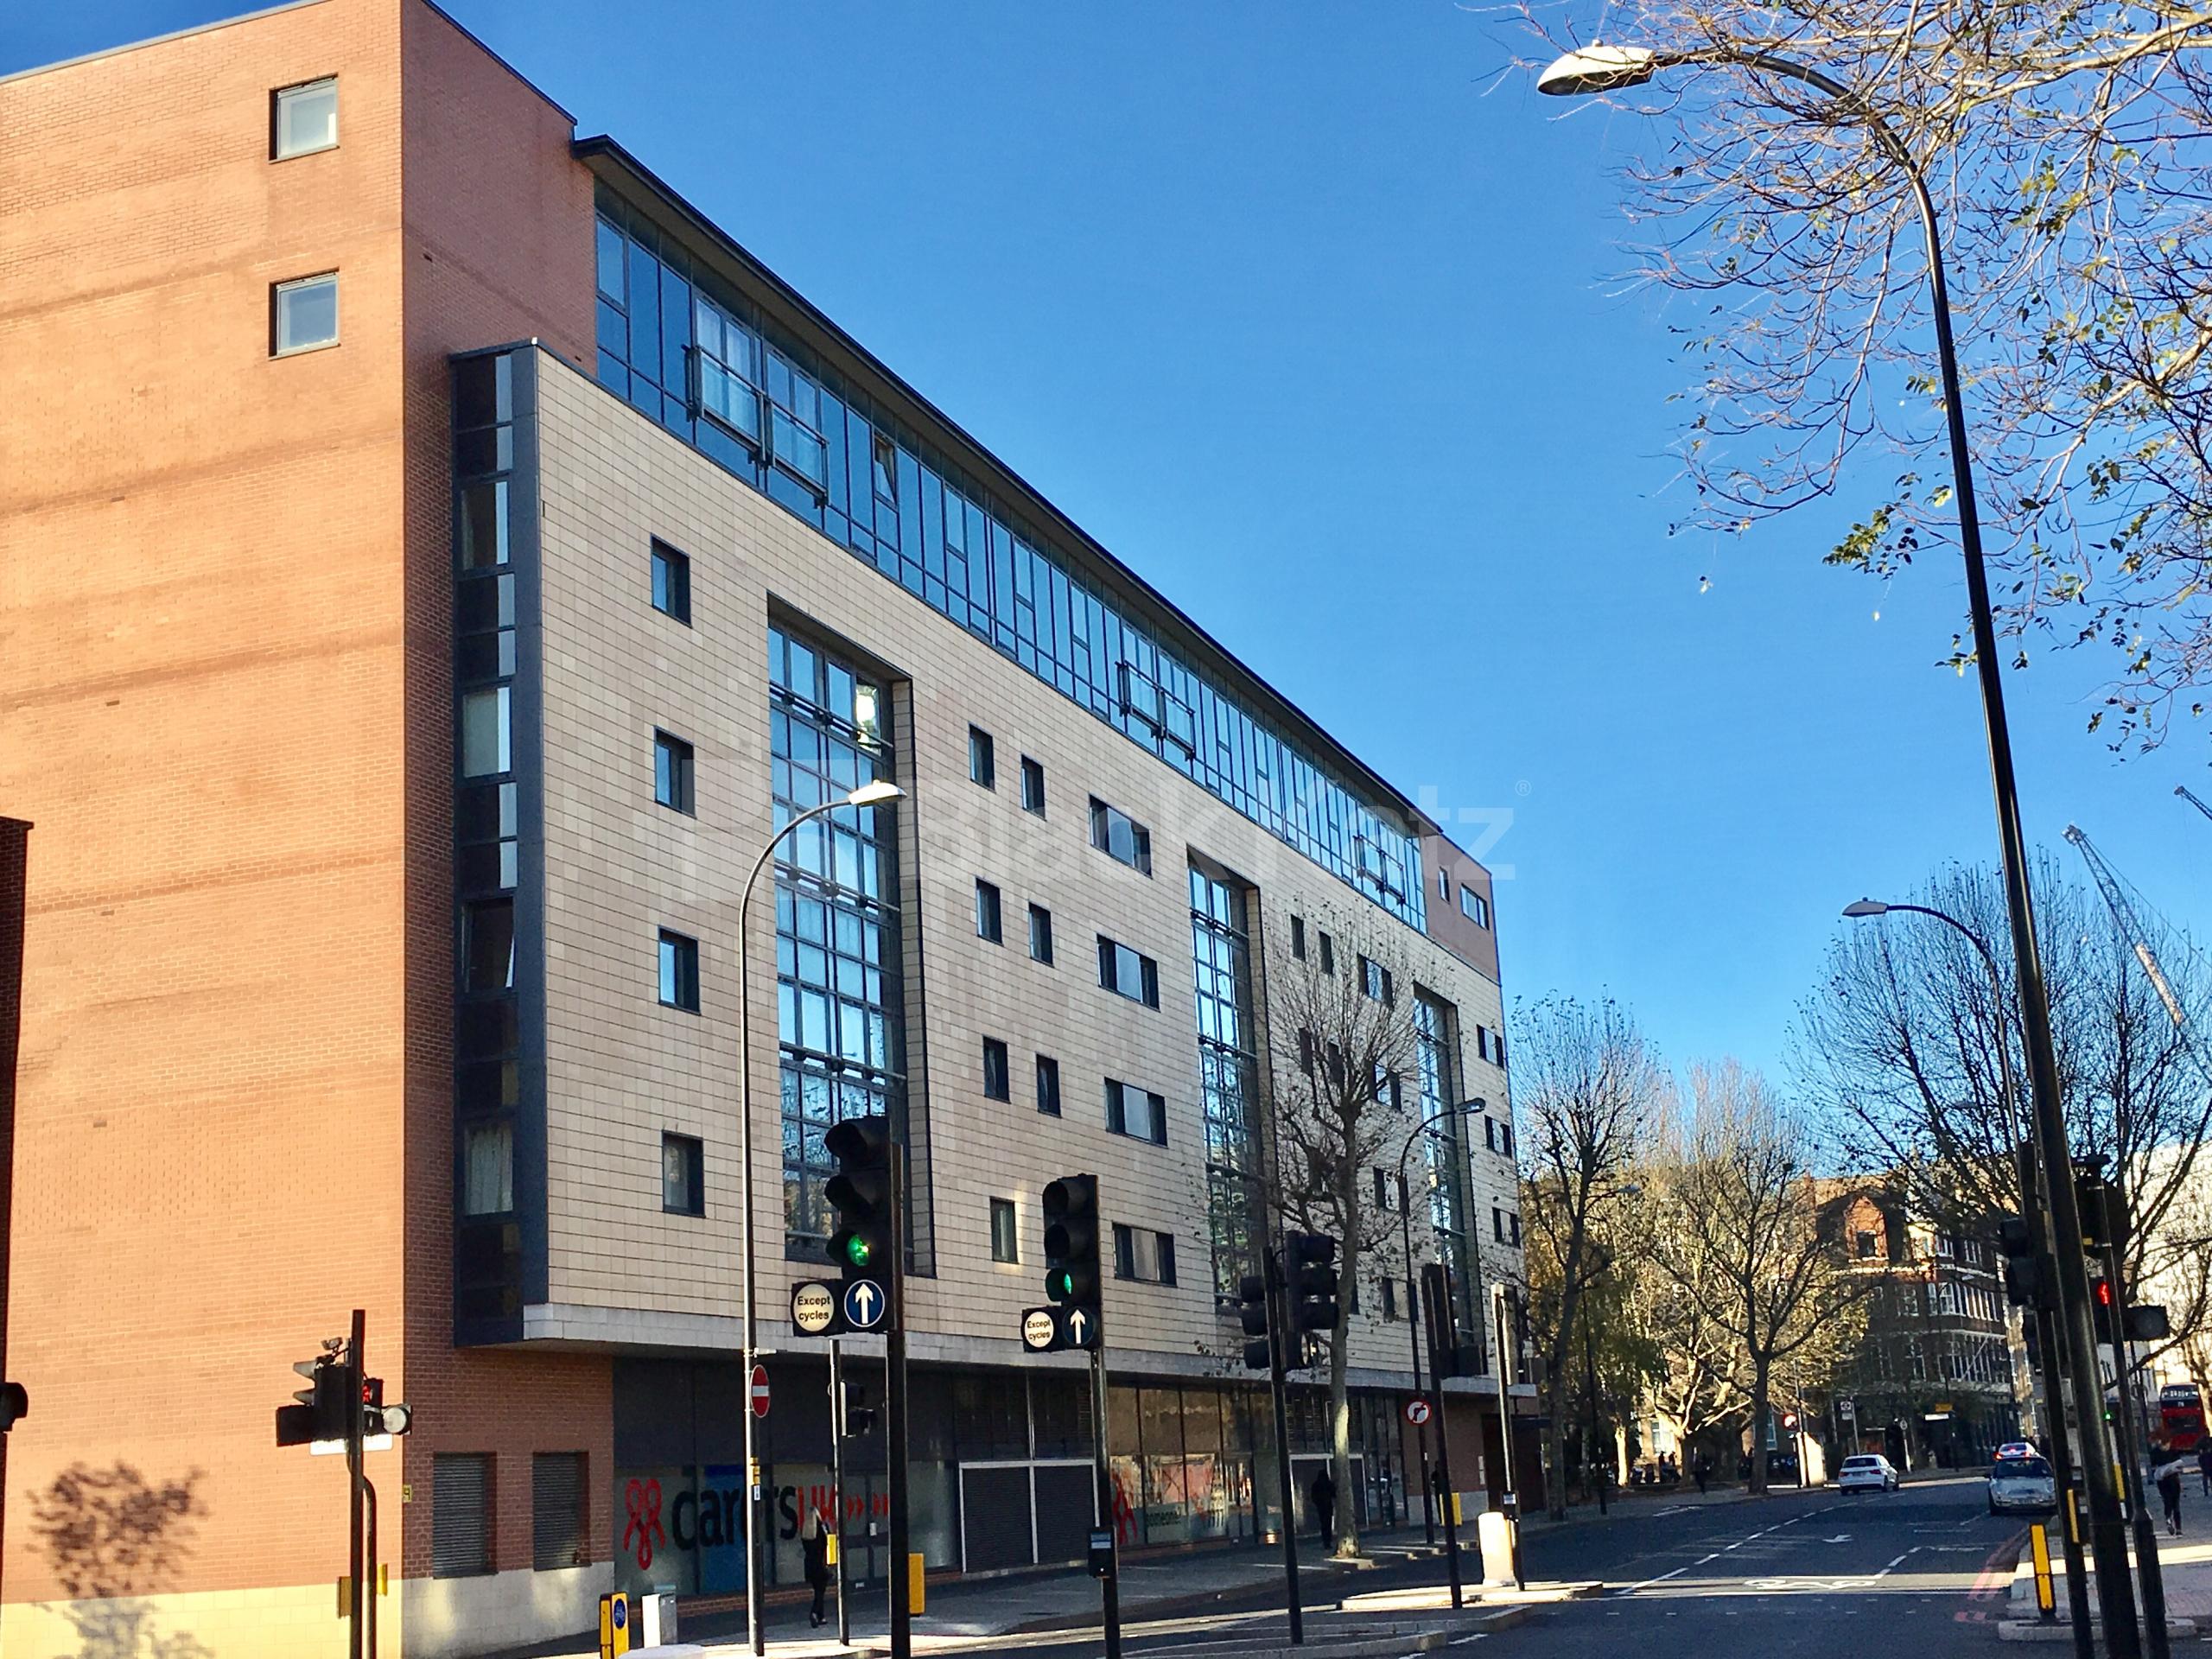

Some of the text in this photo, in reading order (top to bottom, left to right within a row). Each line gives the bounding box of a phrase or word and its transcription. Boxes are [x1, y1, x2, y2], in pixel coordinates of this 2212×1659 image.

[797, 1295, 830, 1306] Except
[798, 1310, 830, 1321] cycles
[1027, 1319, 1051, 1330] Except
[1028, 1331, 1051, 1341] cycles
